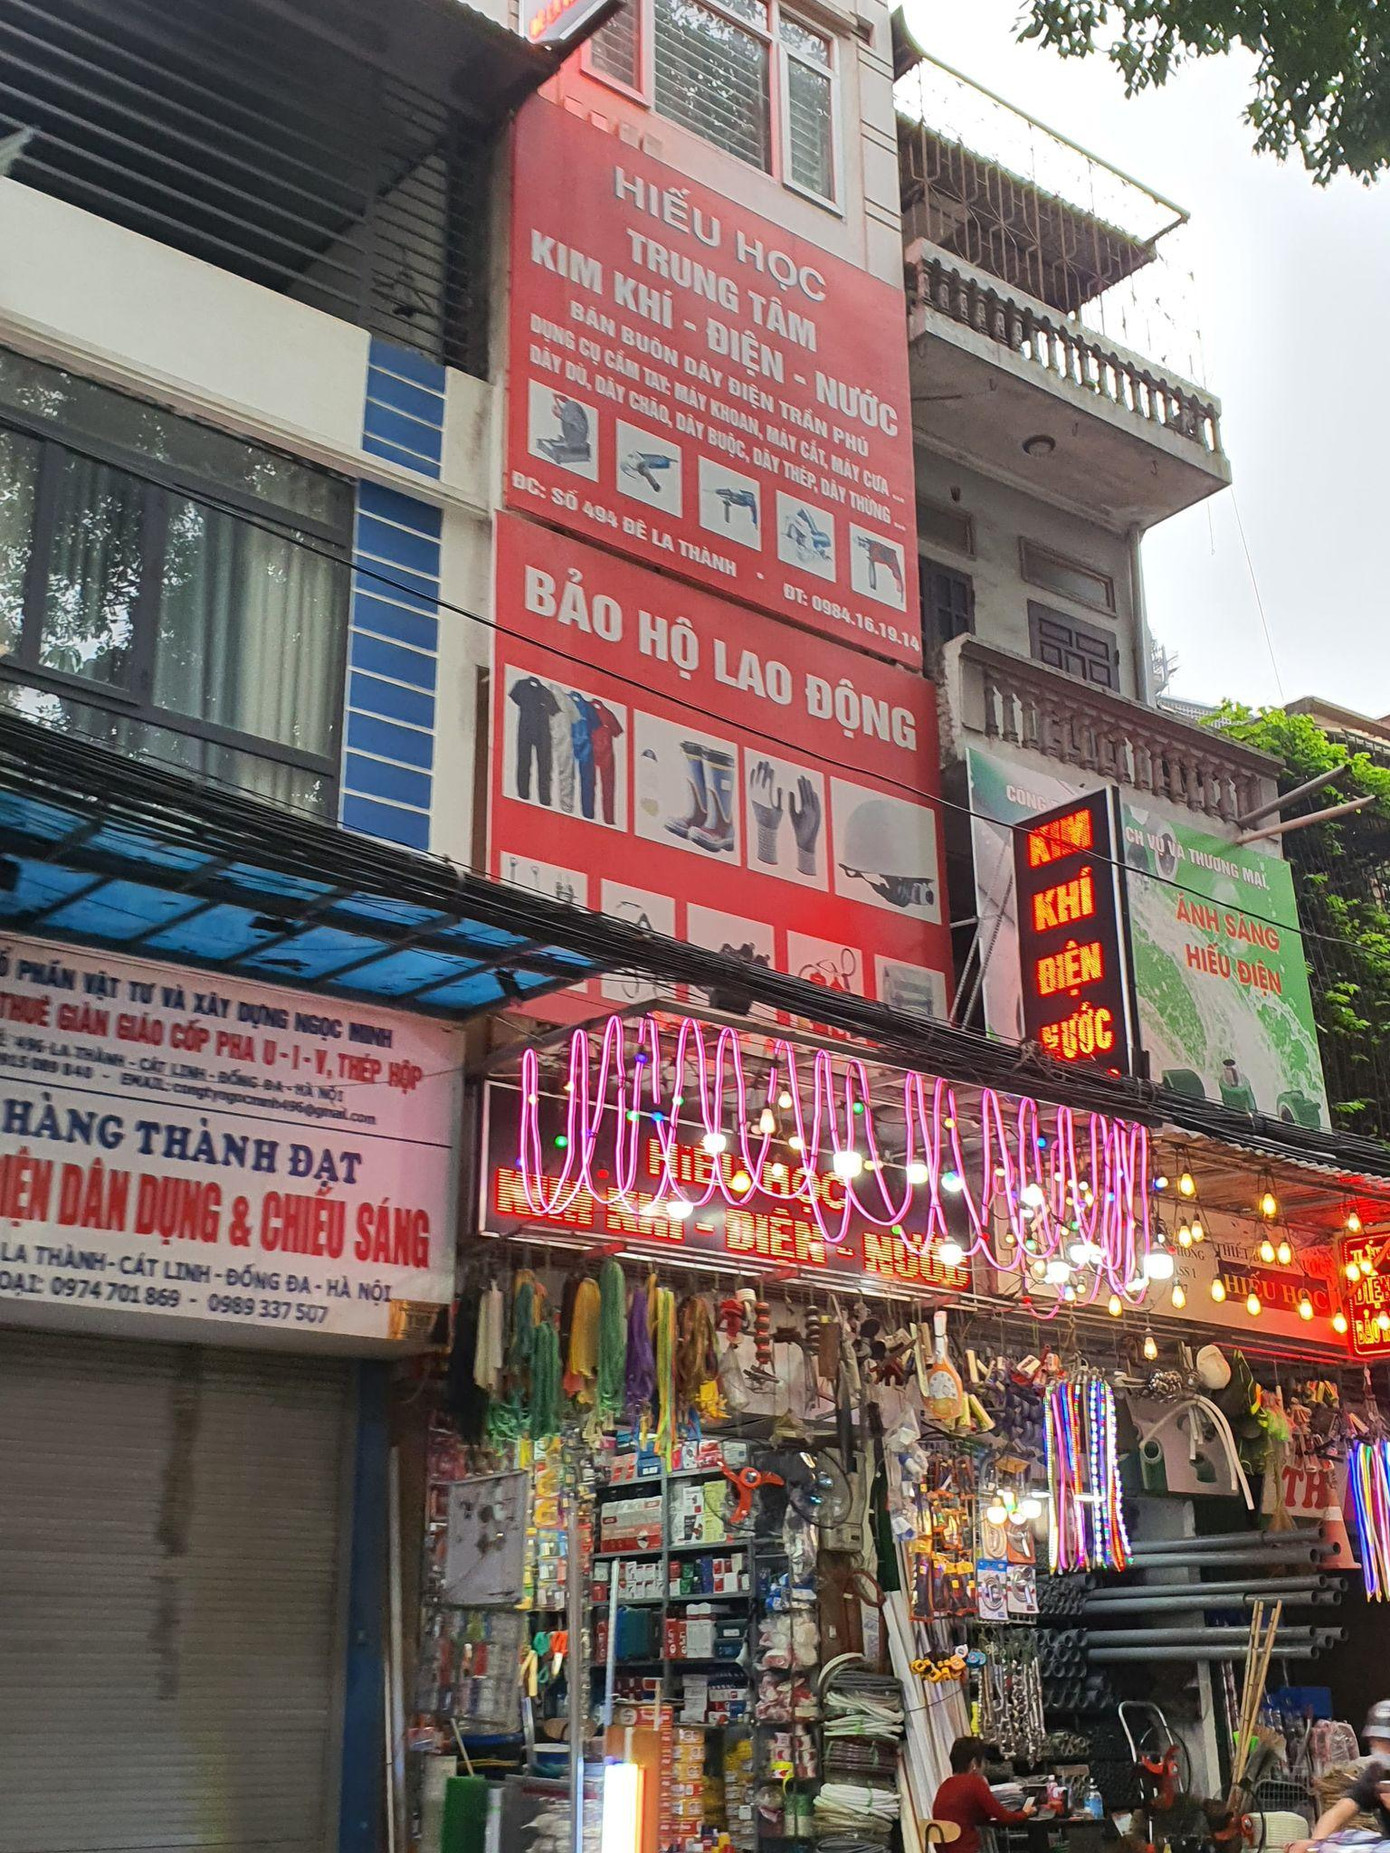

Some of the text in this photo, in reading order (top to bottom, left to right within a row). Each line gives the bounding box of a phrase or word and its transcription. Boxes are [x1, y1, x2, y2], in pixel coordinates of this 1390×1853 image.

[614, 166, 826, 302] HIẾU HỌC
[530, 229, 603, 294] KIM
[614, 270, 673, 330] KHÍ
[707, 315, 785, 384] ĐIỆN
[815, 370, 898, 437] NƯỚC
[627, 227, 817, 352] TRUNG TÂM
[530, 312, 576, 351] DỤNG
[579, 337, 601, 366] CỤ
[604, 349, 640, 381] CẦM
[674, 381, 707, 412] MÁY
[710, 399, 764, 441] KHOAN,
[766, 424, 797, 454] MÁY
[831, 455, 859, 484] MÁY
[863, 468, 889, 497] CƯA
[570, 300, 869, 457] BÁN BUÔN DÂY ĐIỆN TRẦN PHÚ
[530, 344, 562, 374] DÂY
[595, 374, 626, 404] DÂY
[675, 411, 705, 440] DÂY
[753, 446, 782, 474] DÂY
[820, 476, 847, 504] DÂY
[511, 470, 546, 500] ĐC:
[551, 487, 578, 511] SỐ
[582, 501, 619, 529] 494
[623, 513, 648, 541] ĐÊ
[651, 526, 674, 551] LA
[679, 537, 737, 578] THÀNH
[524, 564, 917, 752] BẢO HỘ LAO ĐỘNG
[783, 582, 920, 652] ĐT: 0984.16.19.14
[1027, 808, 1093, 868] KIM
[1188, 847, 1240, 880] THƯƠNG
[1033, 866, 1094, 932] KHÍ
[1224, 911, 1281, 954] SÁNG
[83, 970, 120, 1001] VẬT
[237, 1001, 289, 1029] DỰNG
[295, 1012, 343, 1042] NGỌC
[349, 1022, 393, 1048] MINH
[1185, 941, 1282, 998] HIẾU ĐIỆN
[116, 1012, 164, 1046] GIÁO
[215, 1030, 256, 1062] PHA
[263, 1039, 277, 1066] U
[338, 1052, 382, 1084] THÉP
[388, 1059, 423, 1095] HỘP
[2, 1091, 362, 1187] HÀNG THÀNH ĐẠT
[0, 1146, 430, 1268] IỆN DÂN DỤNG & CHIẾU SÁNG
[1, 1242, 27, 1263] LA
[34, 1244, 106, 1272] THÀNH
[119, 1252, 158, 1277] CÁT
[163, 1261, 210, 1283] LINH
[226, 1263, 281, 1291] ĐỐNG
[286, 1275, 311, 1294] ĐA
[327, 1276, 351, 1298] HÀ
[358, 1279, 392, 1306] NỘI
[51, 1276, 102, 1300] 0974
[106, 1282, 140, 1304] 701
[259, 1299, 292, 1320] 337
[295, 1303, 329, 1324] 507
